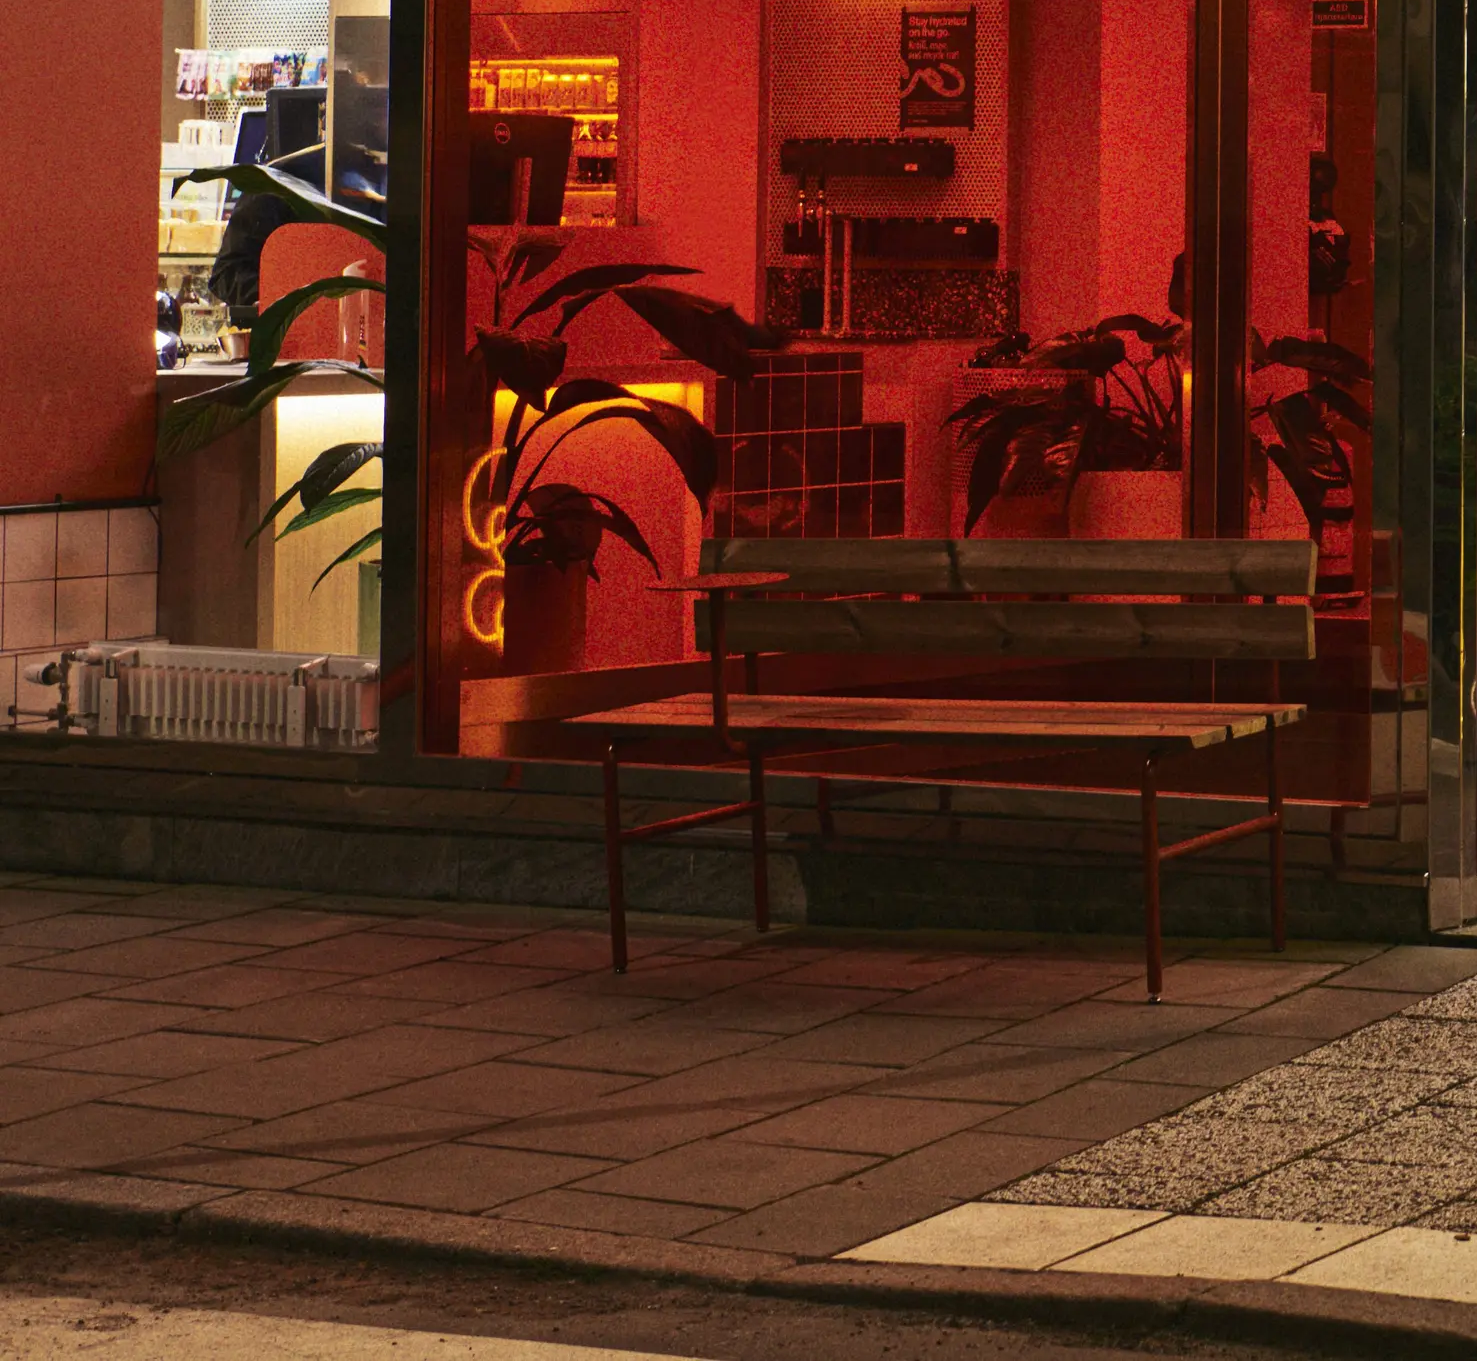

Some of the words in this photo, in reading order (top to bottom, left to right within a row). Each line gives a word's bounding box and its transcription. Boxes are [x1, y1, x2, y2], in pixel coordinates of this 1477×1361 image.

[909, 15, 928, 28] Stay
[929, 15, 968, 28] hydrated
[908, 28, 921, 37] on
[921, 27, 936, 37] the
